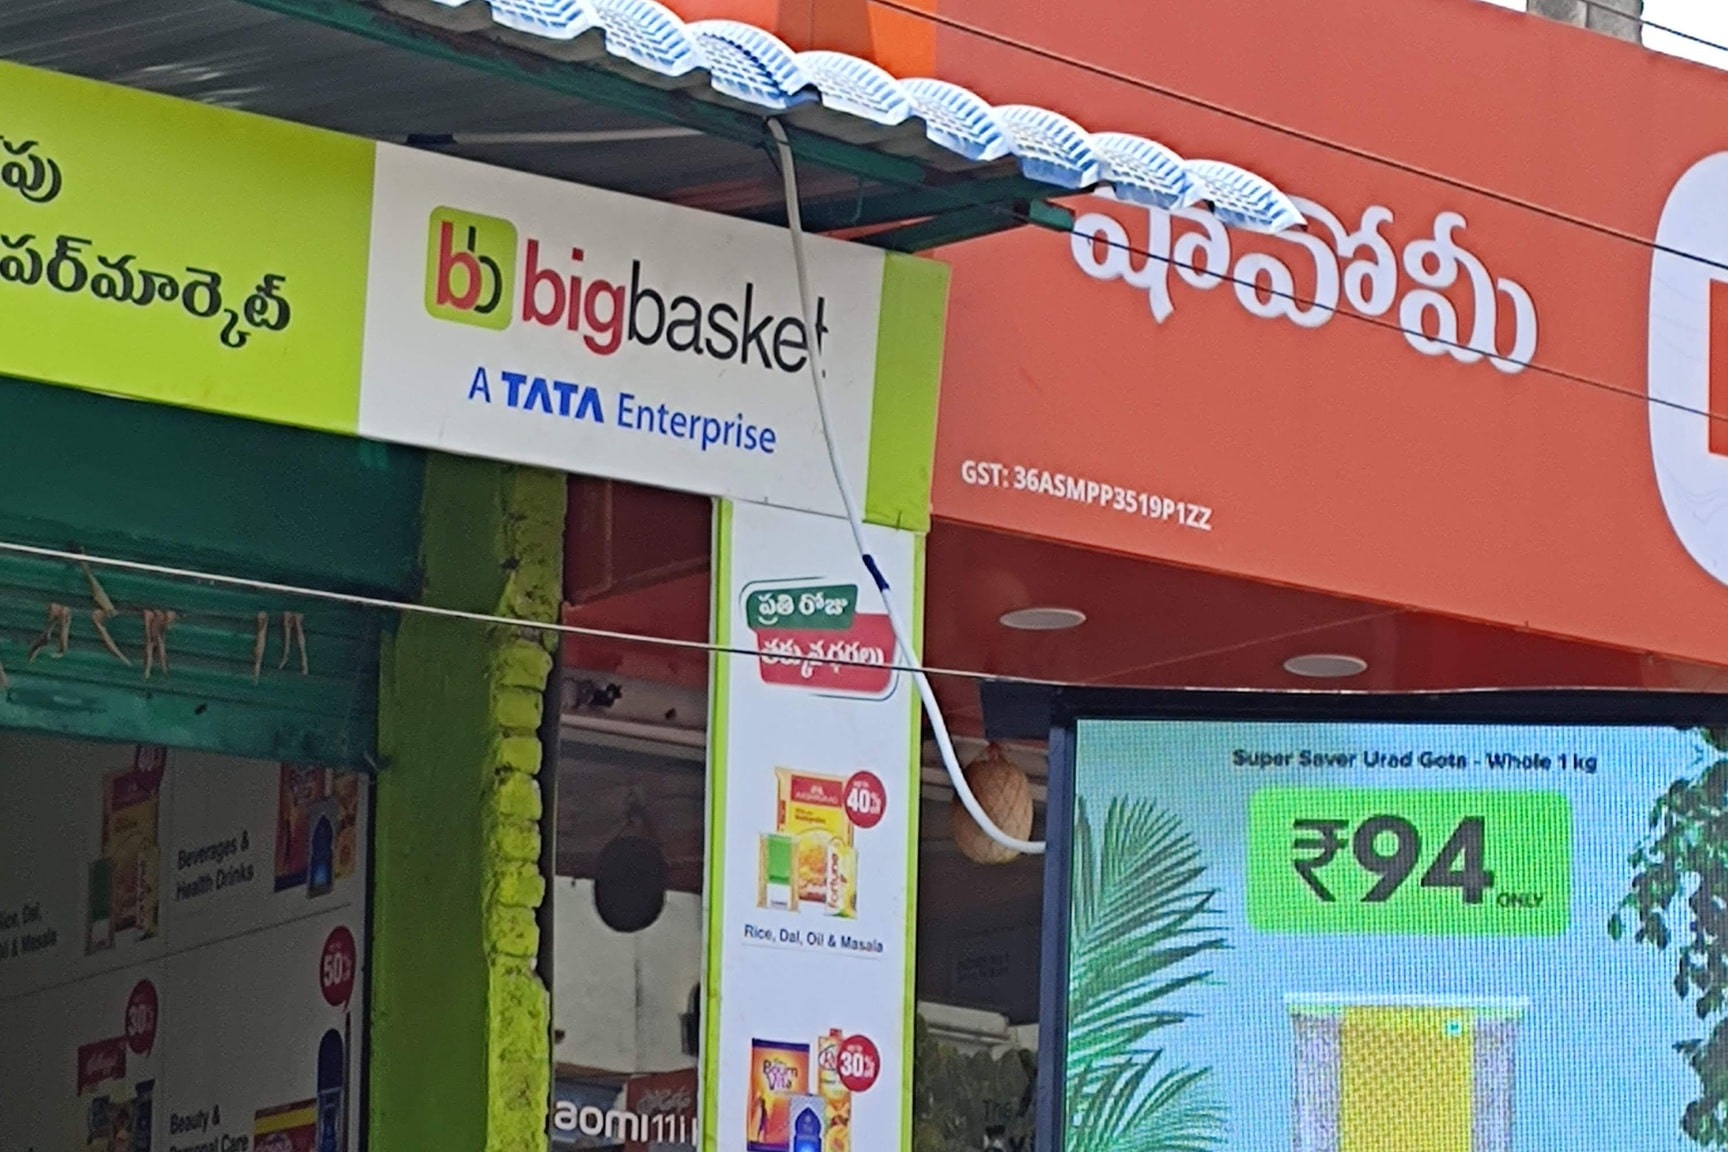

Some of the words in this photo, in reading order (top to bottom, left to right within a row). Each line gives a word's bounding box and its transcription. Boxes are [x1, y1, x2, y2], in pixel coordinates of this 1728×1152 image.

[522, 238, 829, 378] bigbasket
[468, 367, 492, 404] A
[501, 371, 604, 424] TATA
[617, 393, 777, 454] Enterprise
[962, 460, 1010, 488] GST:
[1013, 469, 1212, 532] 36ASMPP3519P1ZZ
[1233, 749, 1292, 769] Super
[1299, 749, 1356, 768] Saver
[1364, 750, 1412, 768] Urad
[1486, 752, 1551, 771] Whole
[1559, 755, 1566, 770] 1
[1572, 754, 1598, 773] kg
[177, 838, 237, 870] Beverages
[1292, 813, 1495, 905] ₹94
[177, 872, 213, 900] Health
[216, 864, 255, 891] Drinks
[744, 924, 777, 943] Rice,
[780, 928, 803, 946] Dal,
[806, 931, 824, 945] Oil
[828, 934, 837, 947] &
[841, 936, 884, 953] Masala
[170, 1110, 211, 1135] Beauty
